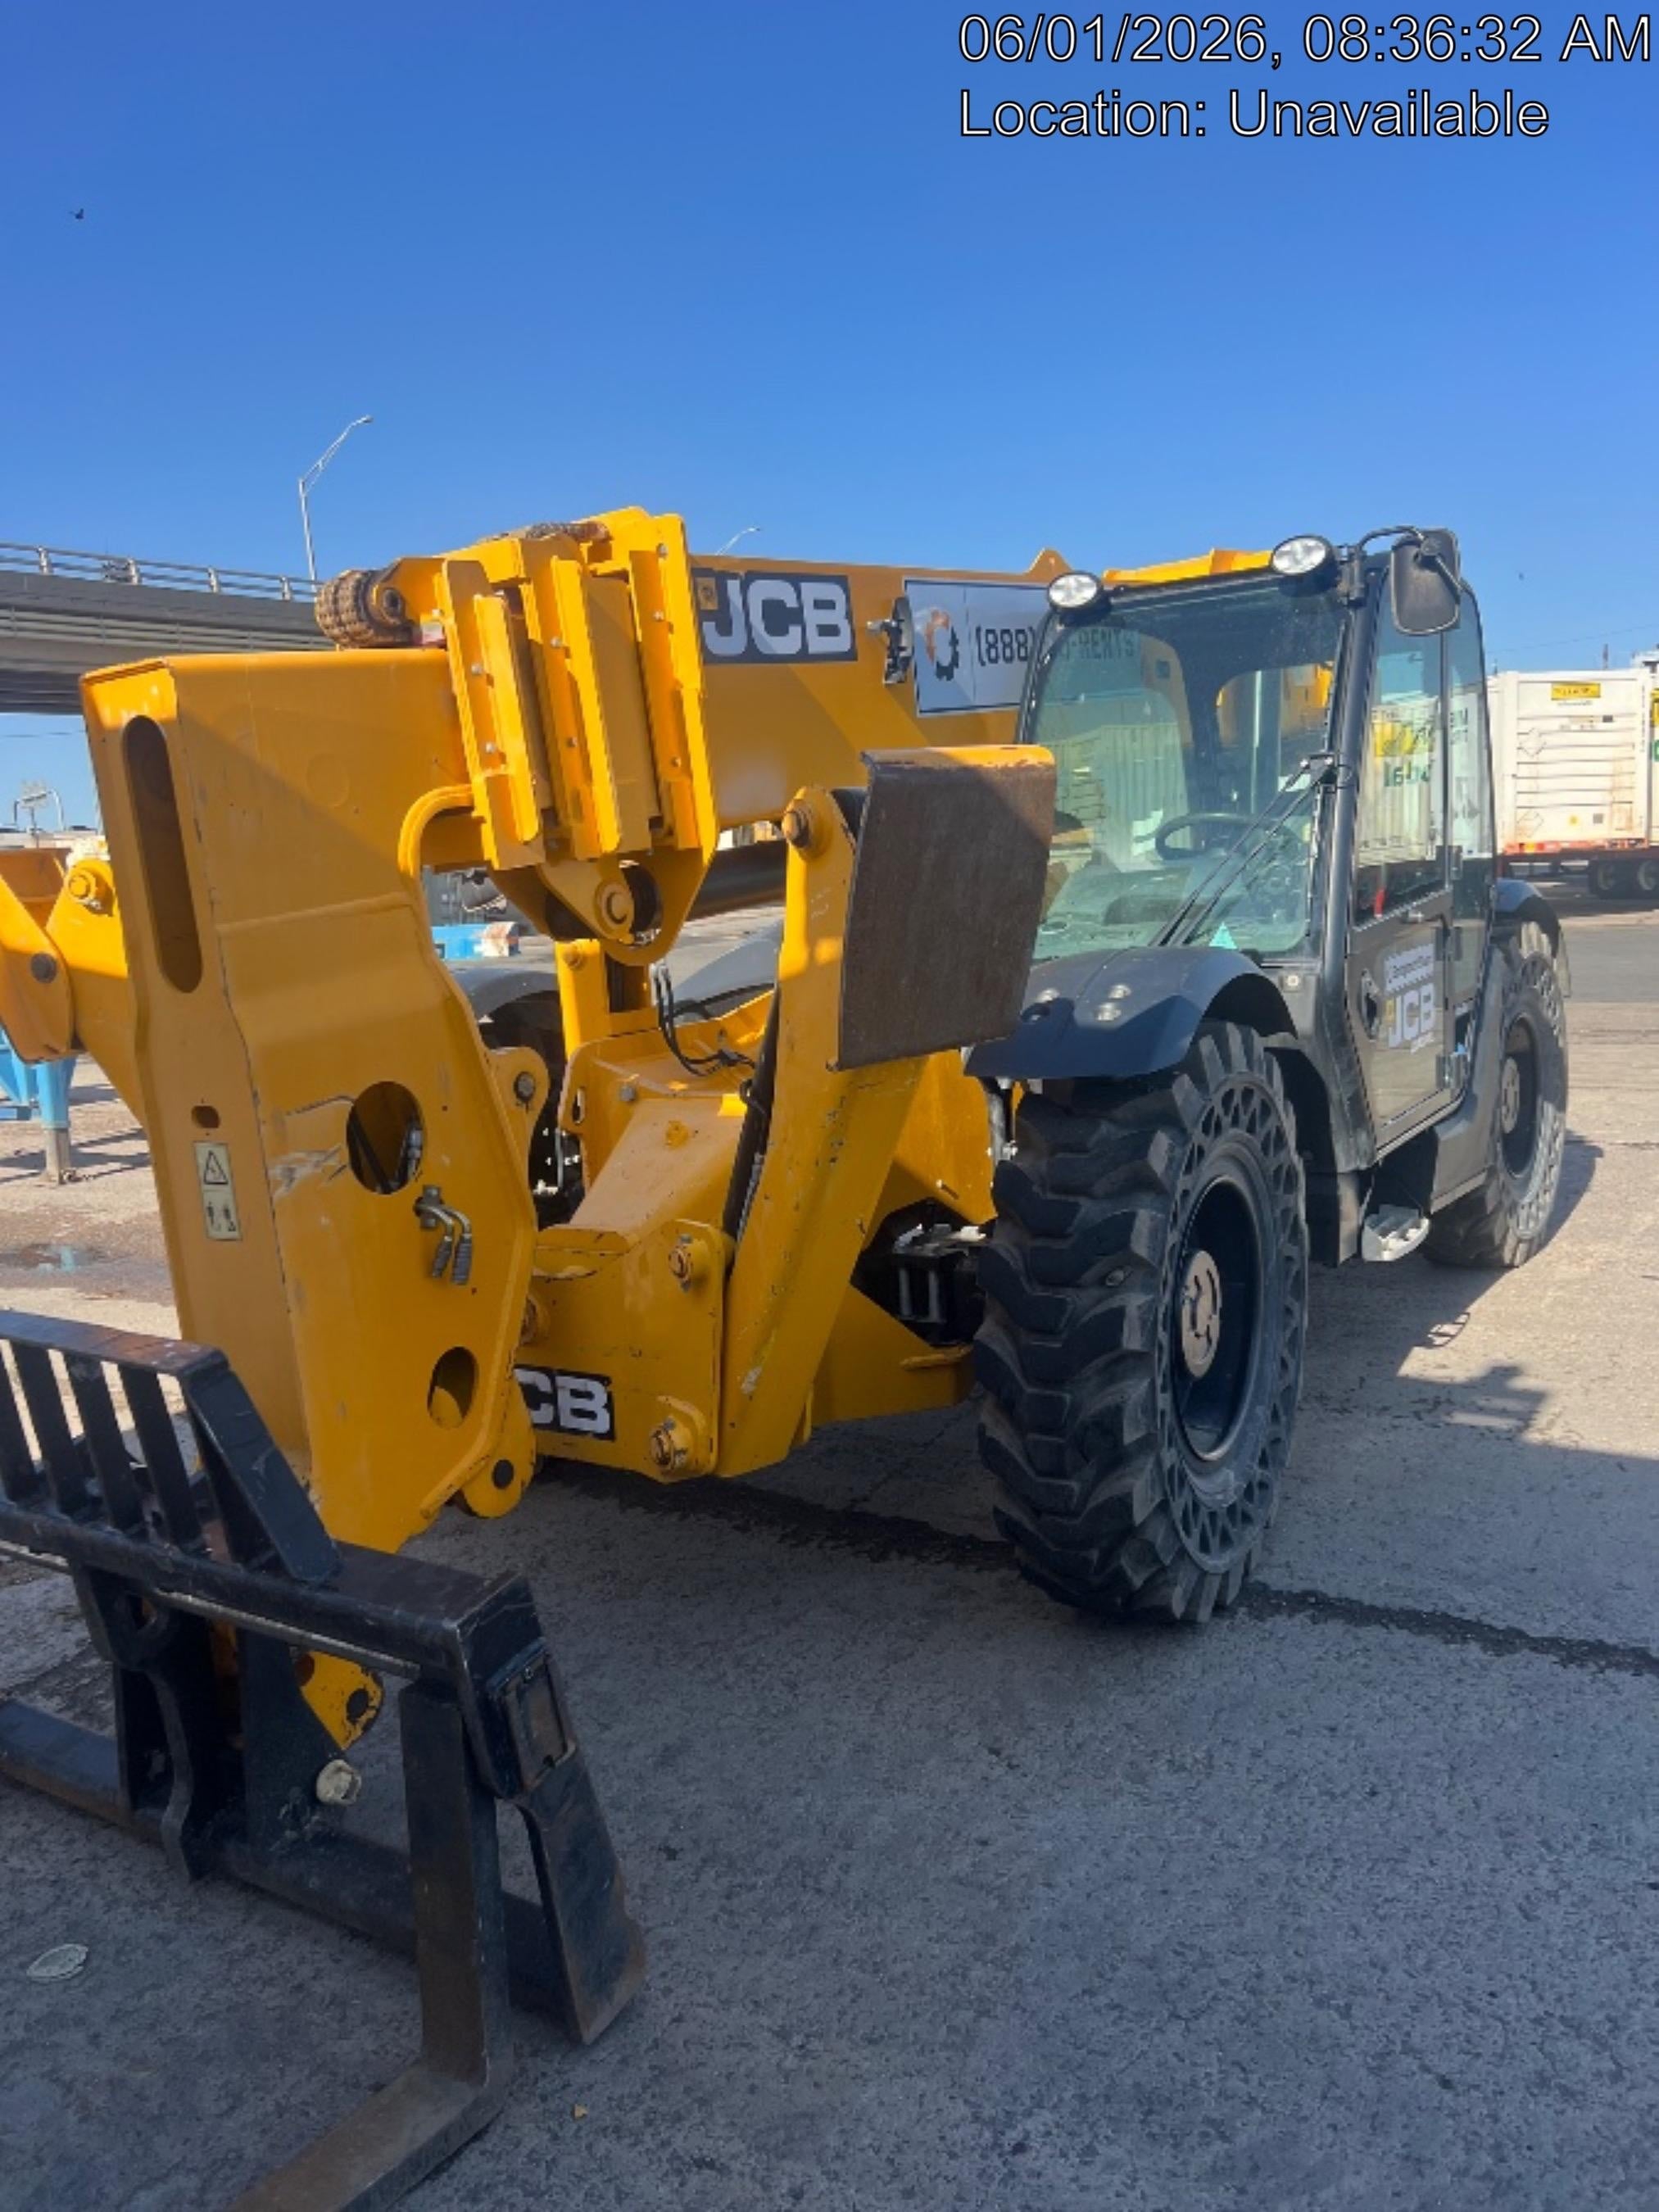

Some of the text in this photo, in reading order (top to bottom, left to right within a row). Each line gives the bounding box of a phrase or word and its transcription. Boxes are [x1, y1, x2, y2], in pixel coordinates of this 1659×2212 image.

[702, 578, 852, 656] JCB
[1388, 983, 1435, 1048] JCB
[513, 1368, 611, 1435] CB
